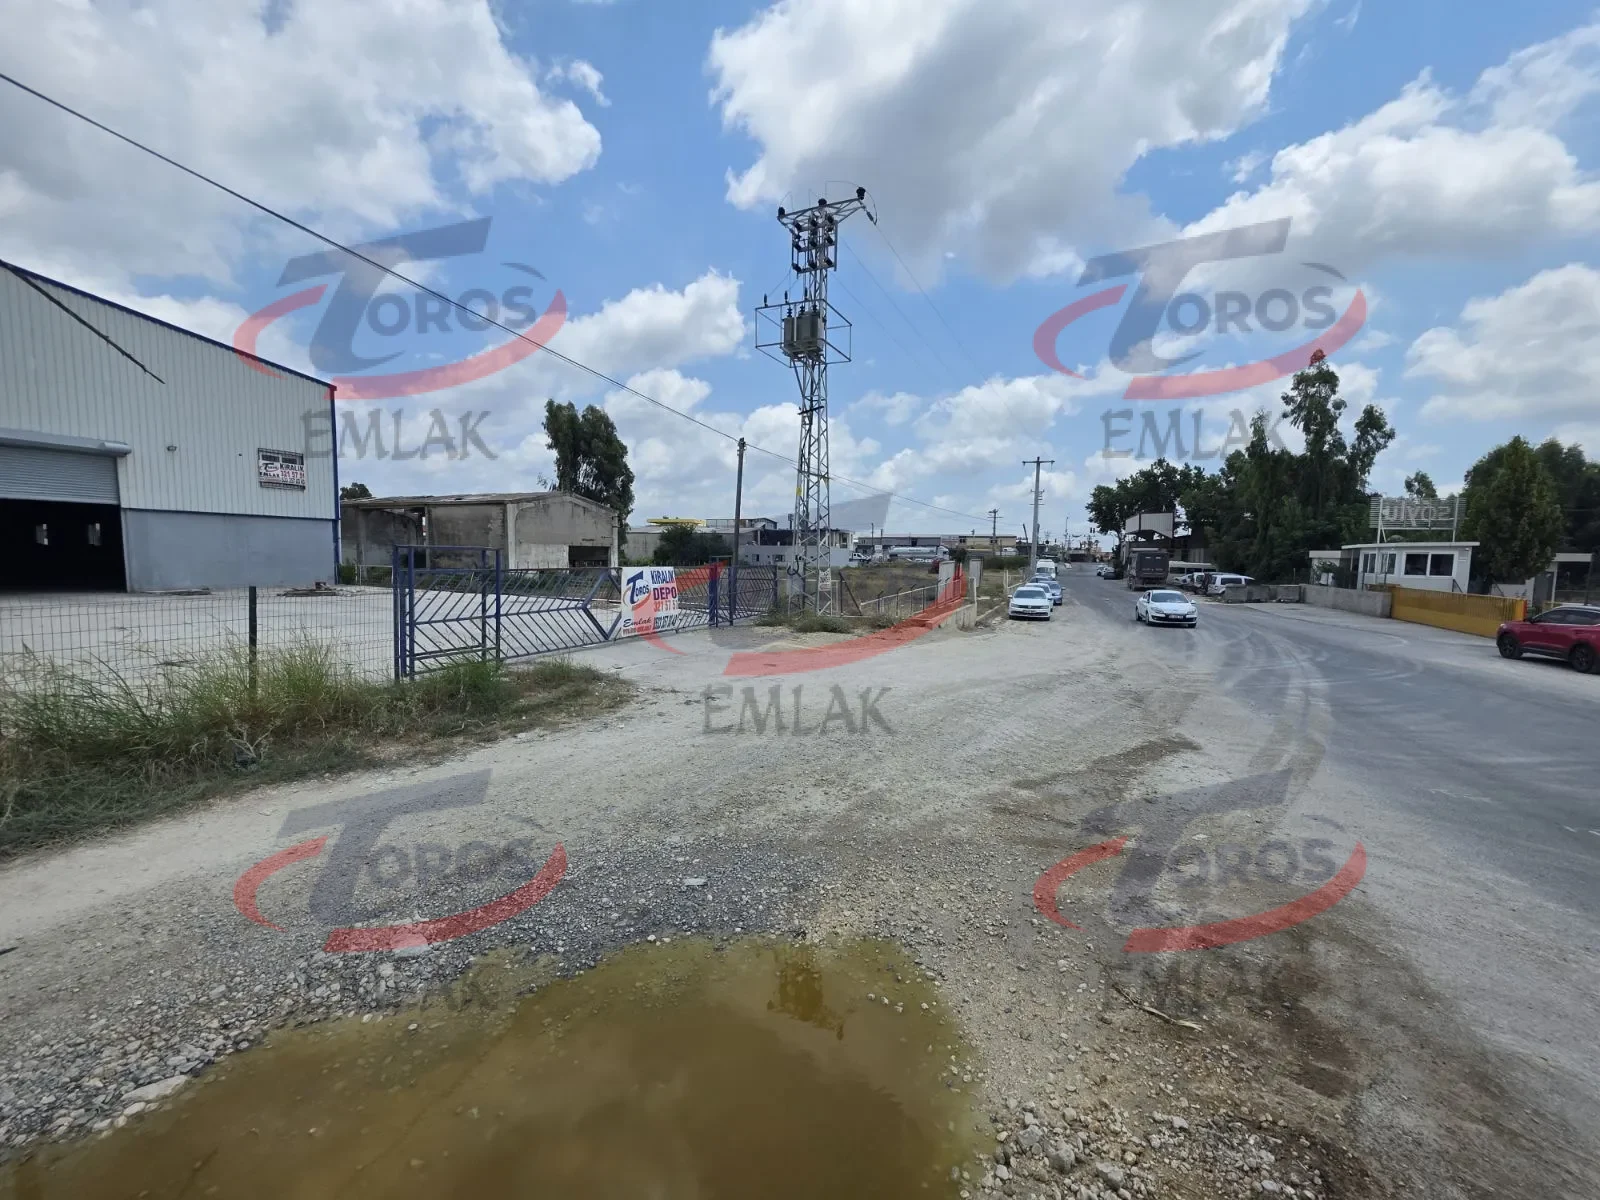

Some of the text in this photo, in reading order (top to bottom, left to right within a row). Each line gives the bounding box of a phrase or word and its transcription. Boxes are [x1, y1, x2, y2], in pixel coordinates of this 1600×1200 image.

[626, 570, 650, 605] TOROS
[653, 586, 677, 600] DEPO
[623, 616, 652, 628] Emlak
